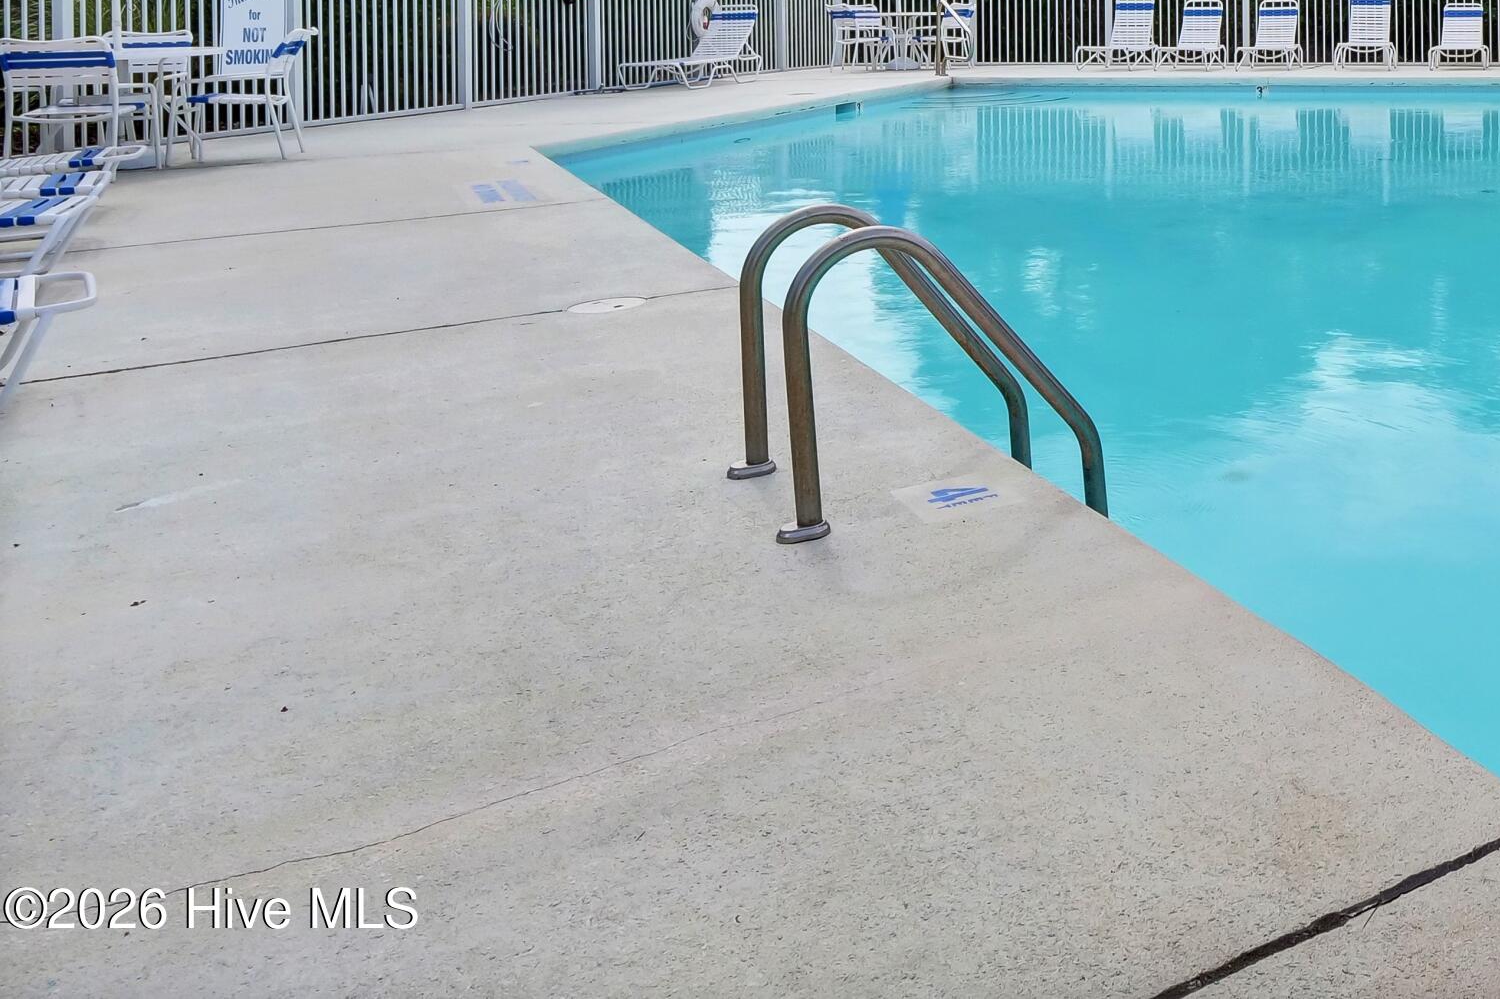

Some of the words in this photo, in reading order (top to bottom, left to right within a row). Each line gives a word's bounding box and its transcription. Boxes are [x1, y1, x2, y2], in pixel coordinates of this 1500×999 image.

[248, 9, 261, 21] for
[242, 27, 267, 43] NOT
[225, 48, 274, 66] SMOKIN
